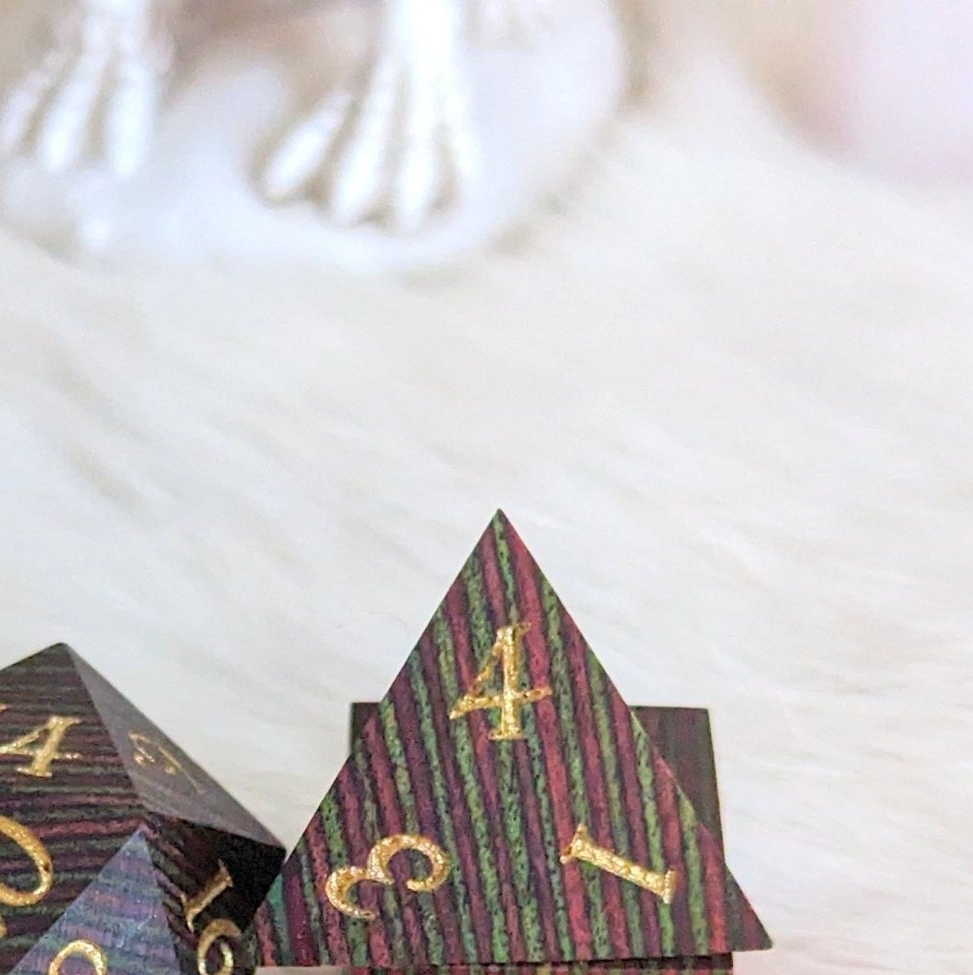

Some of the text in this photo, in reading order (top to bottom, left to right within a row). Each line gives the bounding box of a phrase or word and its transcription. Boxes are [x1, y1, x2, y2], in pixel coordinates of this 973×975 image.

[449, 621, 552, 740] 4
[325, 832, 451, 922] 3
[559, 822, 681, 904] 1
